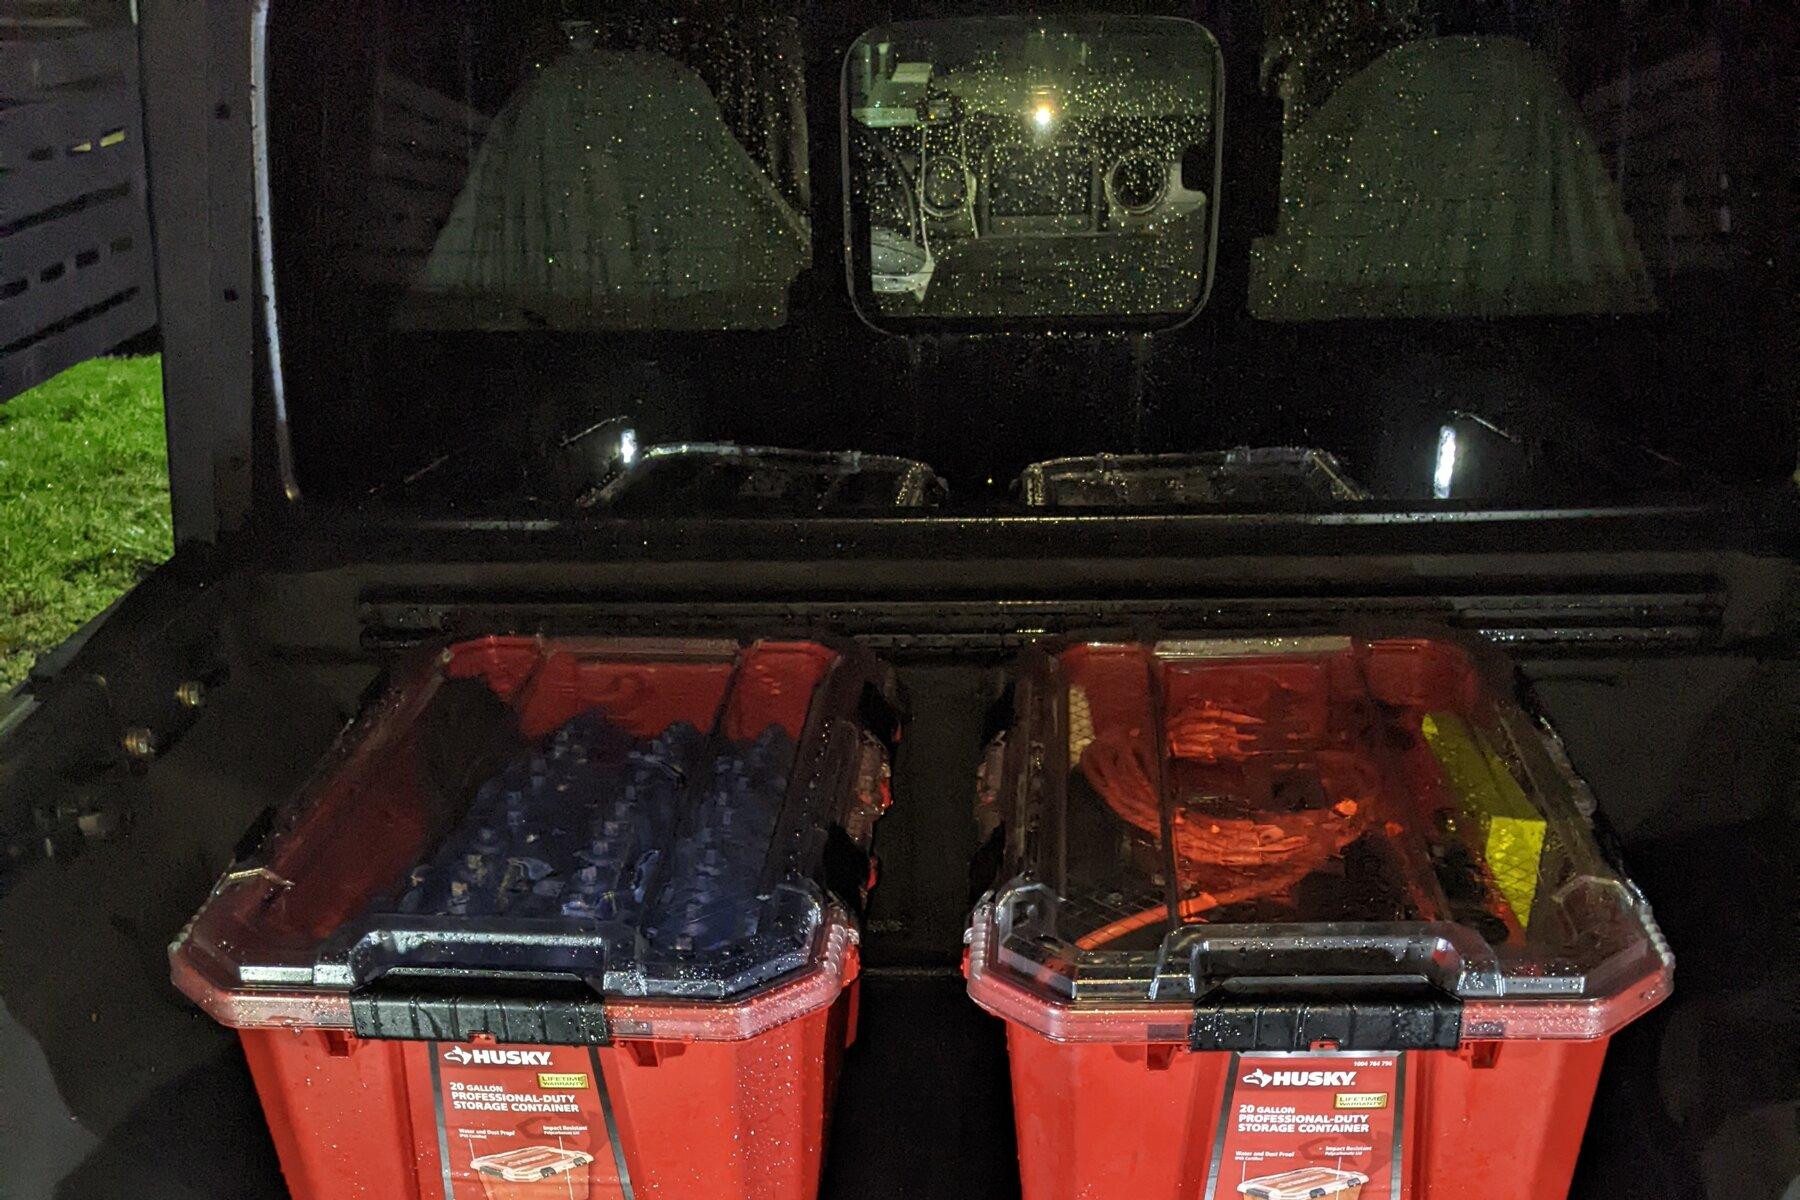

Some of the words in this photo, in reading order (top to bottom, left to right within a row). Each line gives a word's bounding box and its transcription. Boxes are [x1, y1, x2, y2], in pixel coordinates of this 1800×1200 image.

[472, 1050, 552, 1065] HUSKY
[1272, 1071, 1357, 1086] HUSKY
[450, 1082, 464, 1091] 20
[466, 1084, 503, 1092] GALLON
[452, 1092, 575, 1103] PROFESSIONAL-DUTY
[454, 1101, 508, 1111] STORAGE
[511, 1103, 579, 1112] CONTAINER
[1239, 1104, 1255, 1113] 20
[1238, 1114, 1369, 1123] PROFESSIONAL-DUTY
[1238, 1123, 1295, 1132] STORAGE
[1298, 1124, 1369, 1133] CONTAINER
